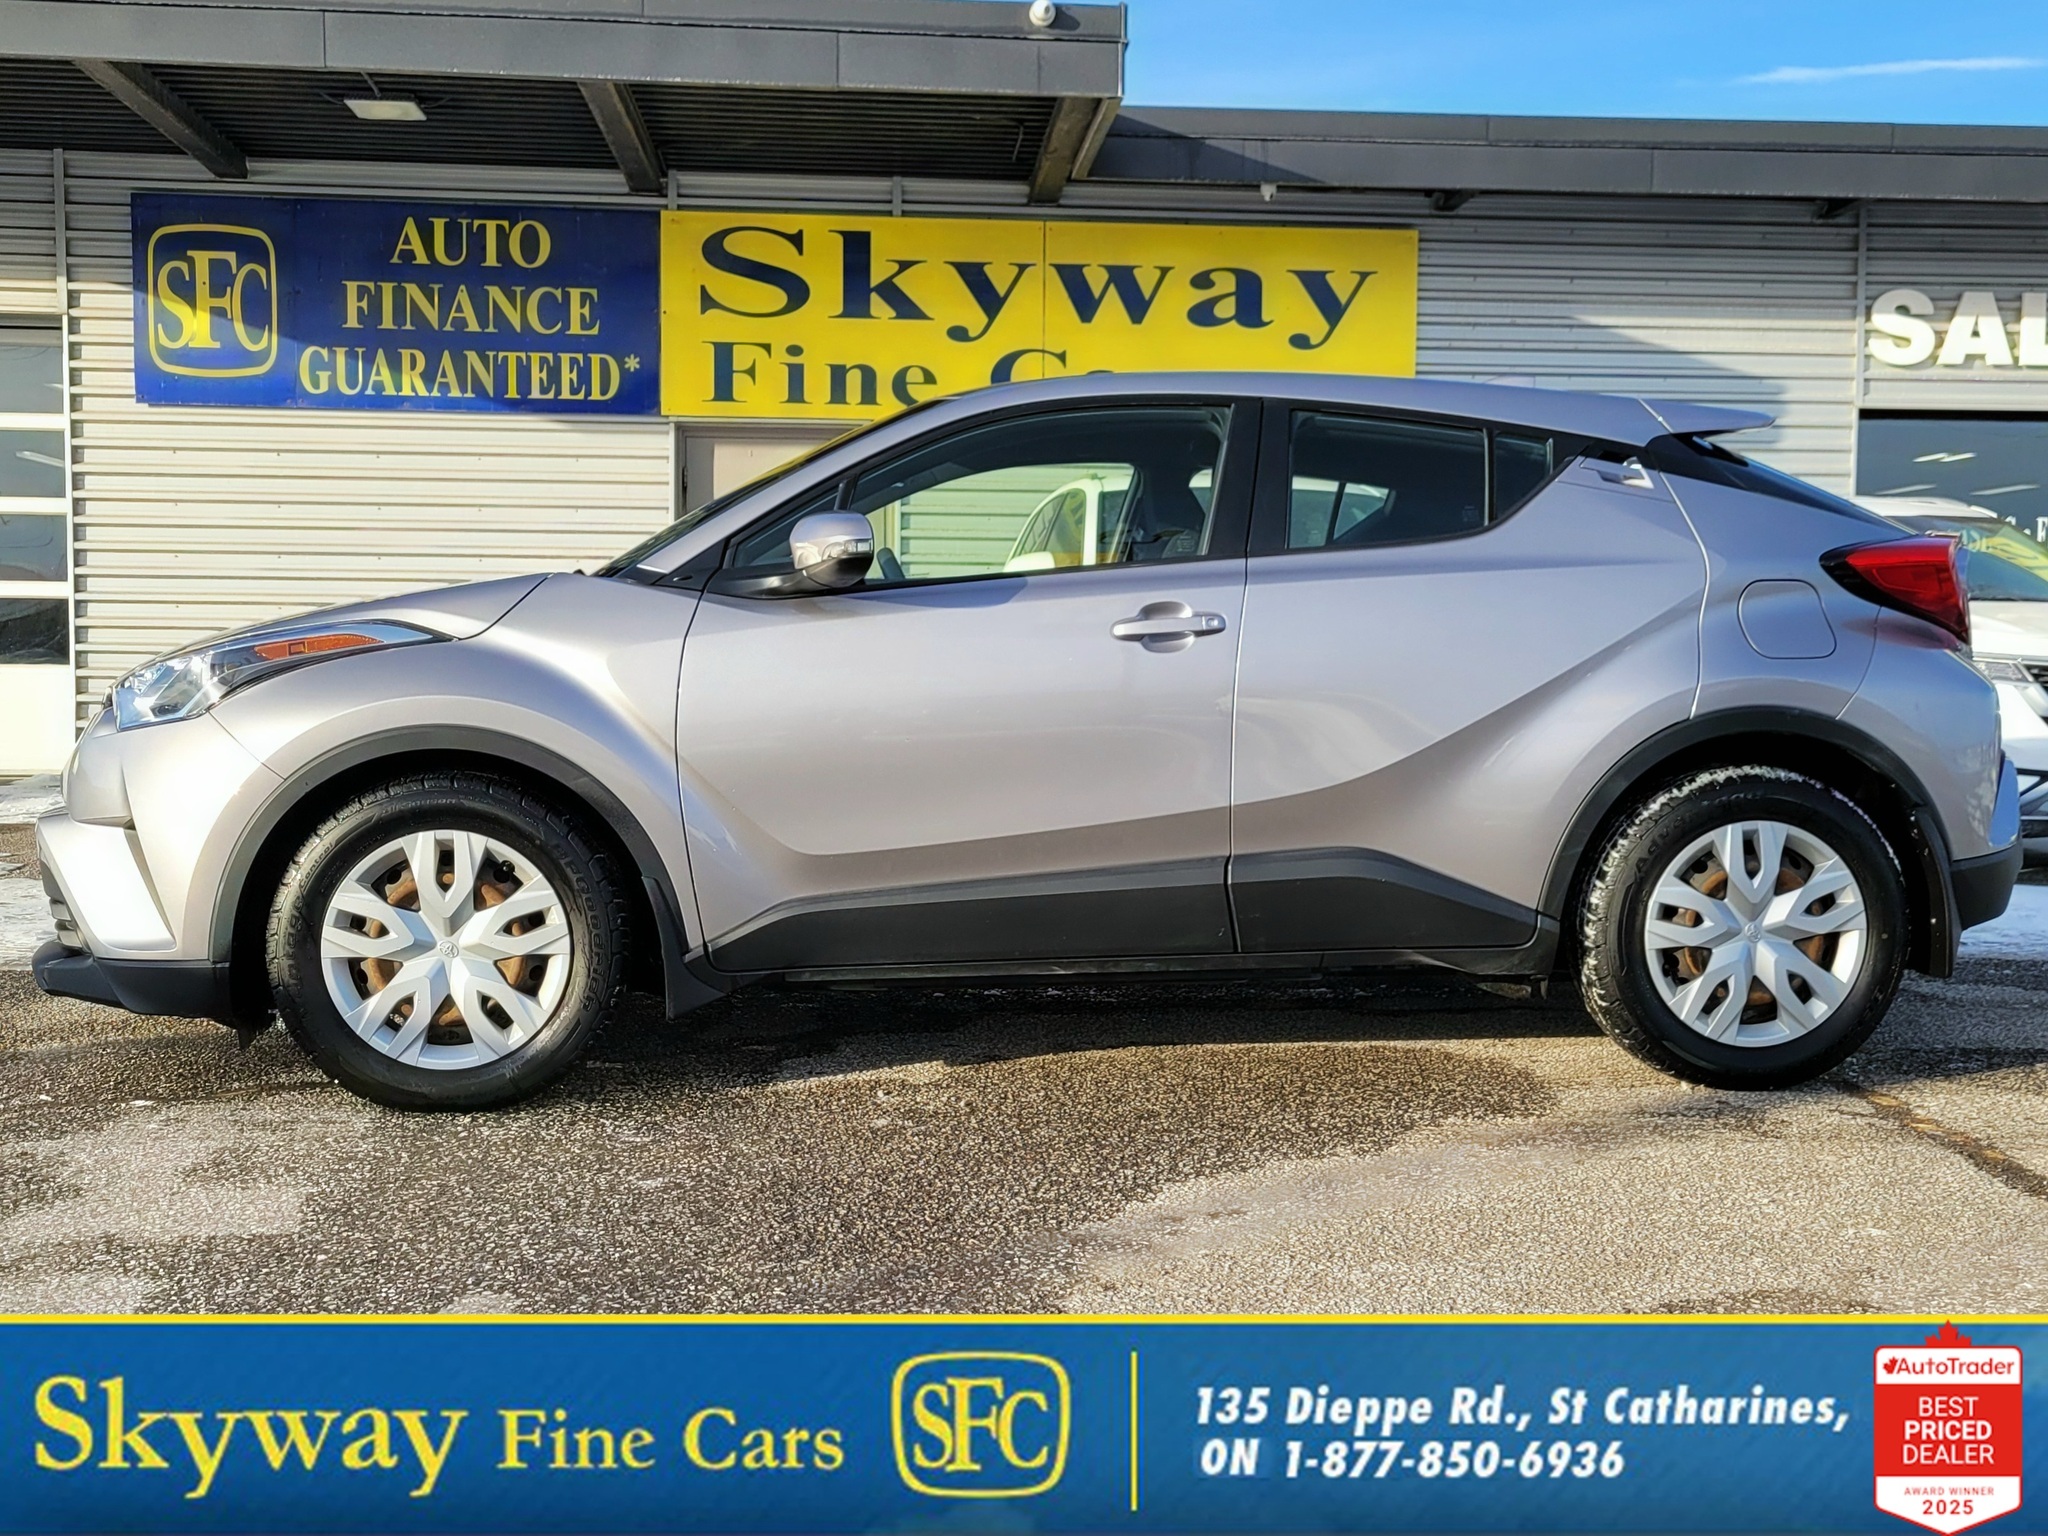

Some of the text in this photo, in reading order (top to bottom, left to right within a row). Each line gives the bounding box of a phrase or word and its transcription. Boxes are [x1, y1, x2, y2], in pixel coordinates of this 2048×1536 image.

[389, 216, 551, 269] AUTO
[156, 250, 270, 353] SFC
[341, 280, 601, 336] FINANCE
[699, 225, 1378, 351] Skyway
[702, 340, 939, 408] Fine
